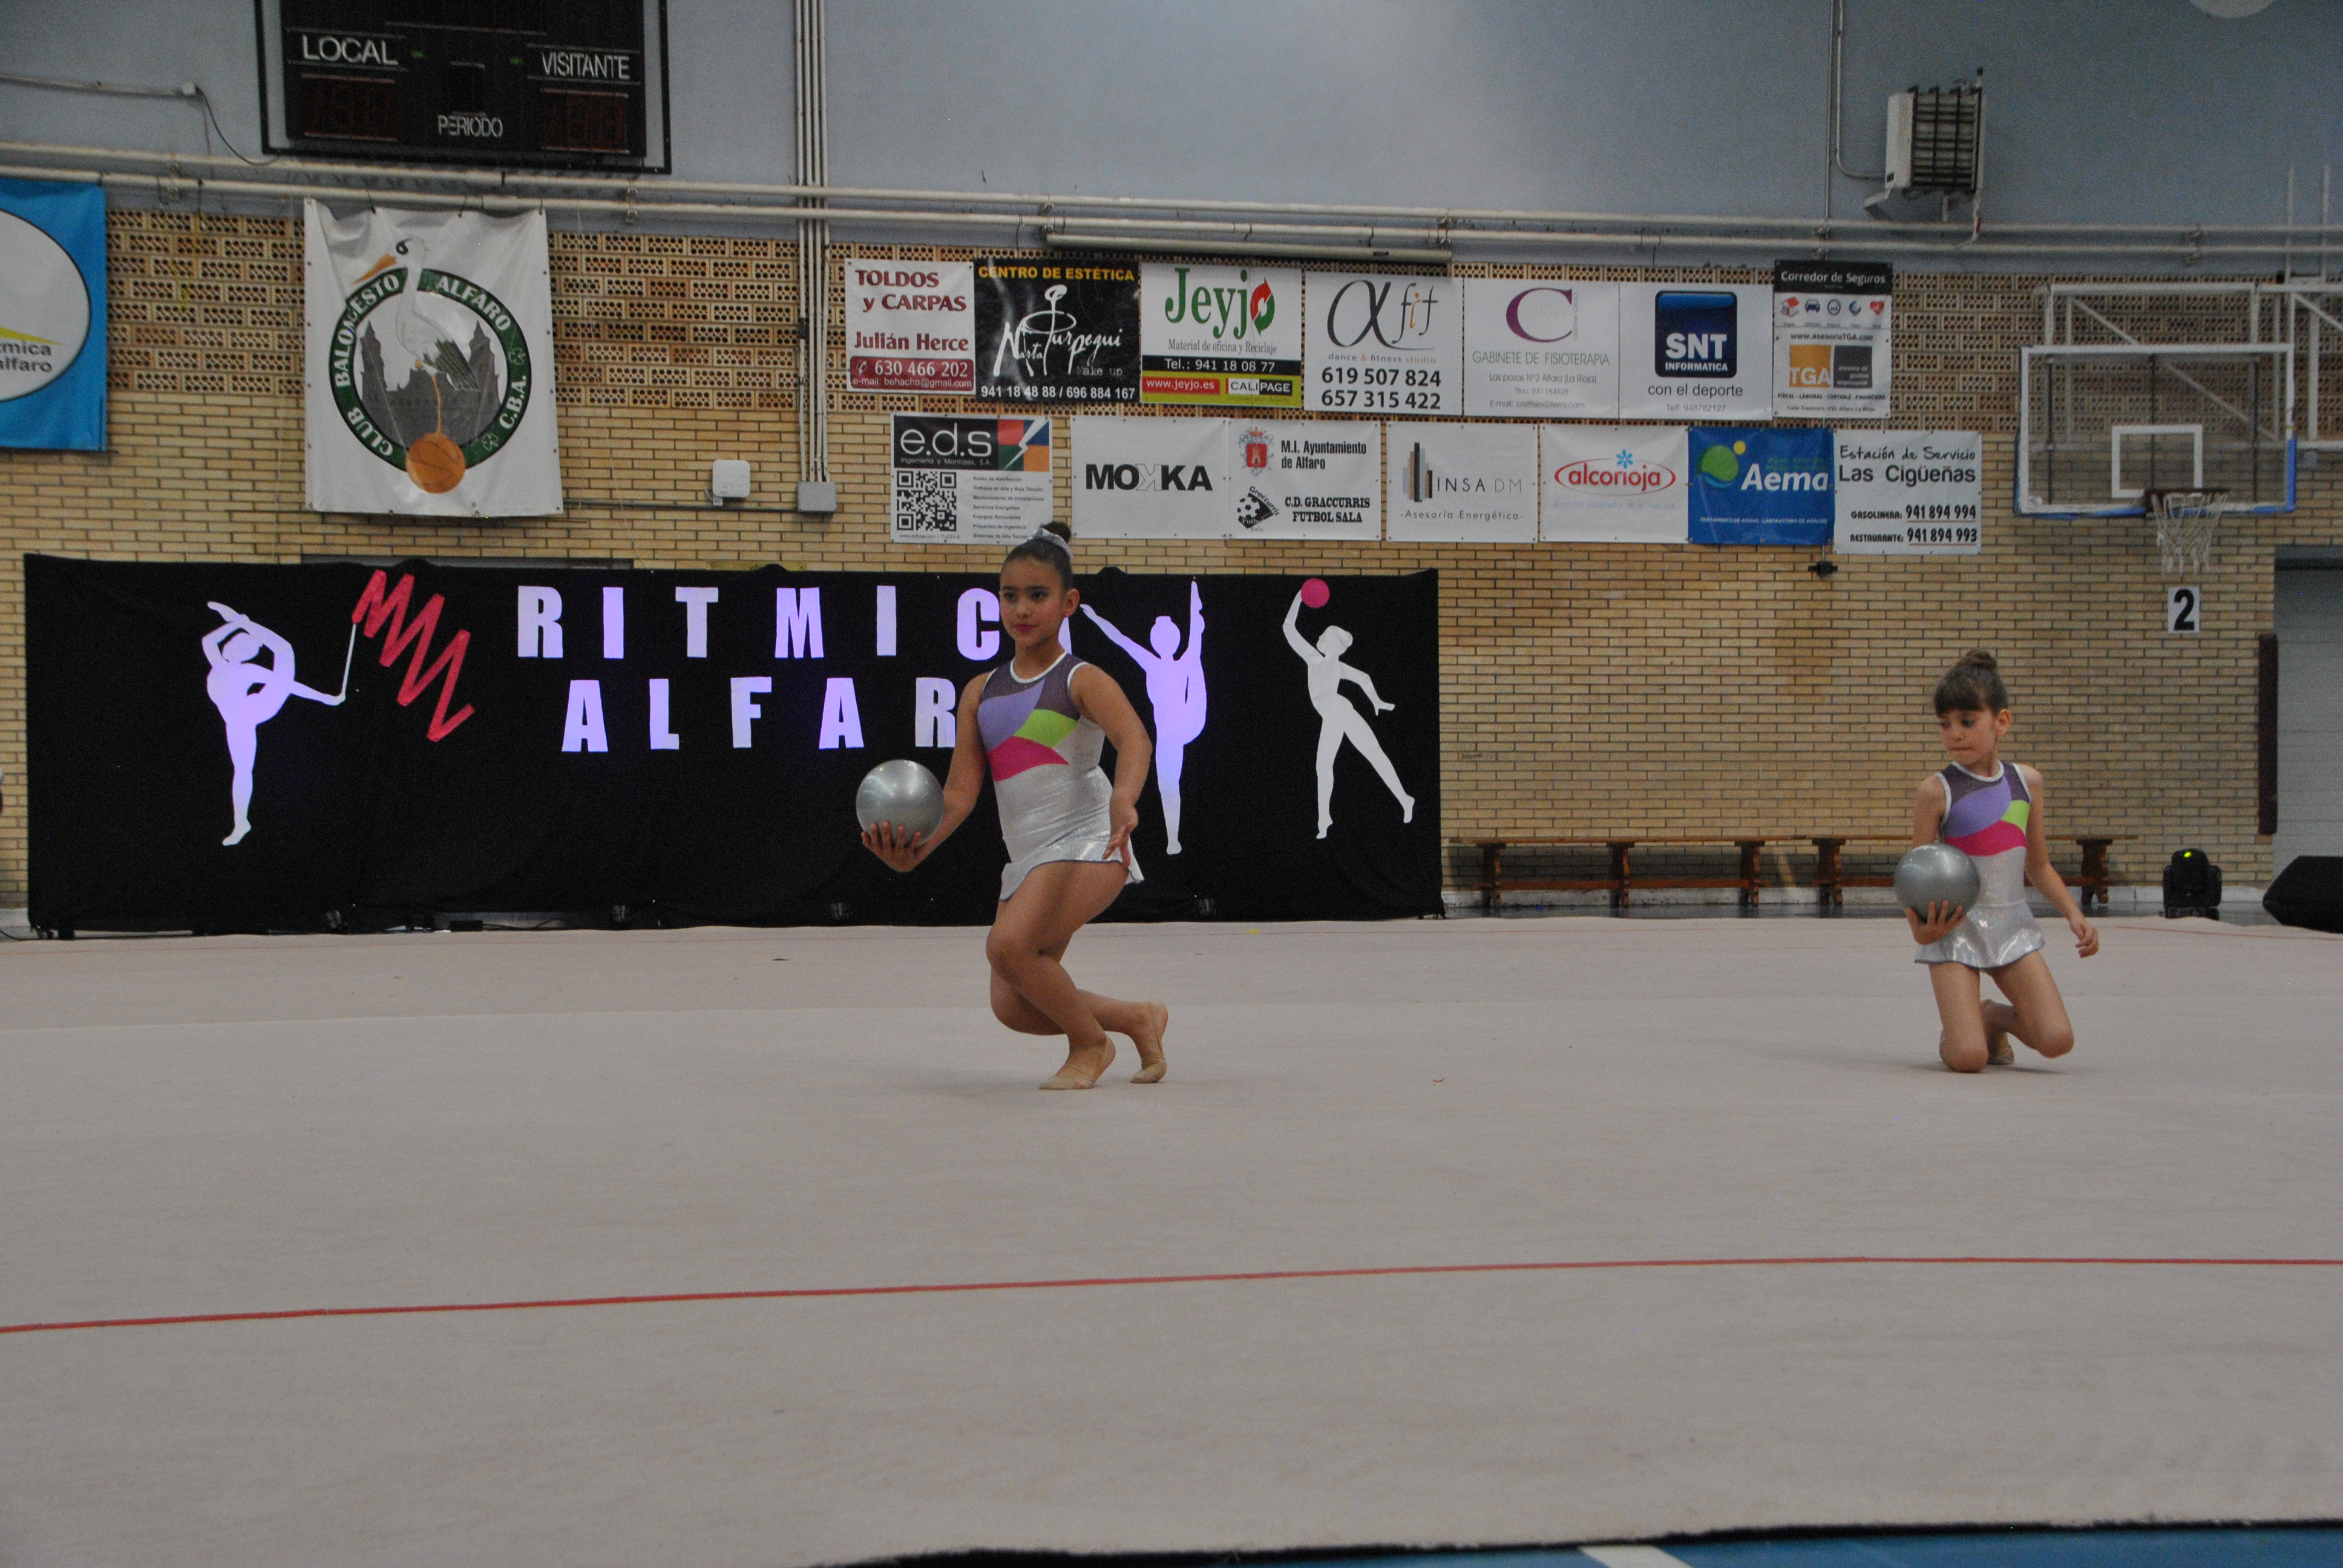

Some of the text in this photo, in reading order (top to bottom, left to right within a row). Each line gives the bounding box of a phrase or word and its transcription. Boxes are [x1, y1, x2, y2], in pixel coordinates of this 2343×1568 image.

[302, 34, 399, 65] LOCAL
[542, 52, 630, 80] VISITANTE
[437, 115, 503, 138] PERIODO
[854, 269, 940, 287] TOLDOS
[978, 266, 1135, 281] CENTRO DE ESTÉTICA
[1781, 271, 1886, 286] Corredor de Seguros
[436, 275, 511, 331] ALFARO
[862, 294, 967, 313] y CARPAS
[854, 332, 969, 351] Julián Herce
[1168, 339, 1277, 355] Material de oficina y Reciclaje
[1665, 333, 1727, 359] SNT
[1165, 358, 1275, 372] Tel.: 941 18 08 77
[1472, 351, 1610, 365] GABINETE DE FISIOTERAPIA
[875, 360, 968, 377] 630 466 202
[1076, 365, 1123, 377] Make up
[1322, 367, 1441, 387] 619 507 824
[1790, 367, 1830, 385] TGA
[1147, 379, 1290, 392] www.jeyjo.es CALIPAGE
[1542, 374, 1562, 382] Alfaro
[981, 385, 1135, 400] 941 18 48 88 696 884 167
[1322, 389, 1440, 410] 657 315 422
[1648, 383, 1743, 399] con el deporte
[499, 374, 526, 430] C.B.A.
[347, 407, 393, 456] CLUB
[1281, 440, 1366, 456] M.I. Ayuntamiento
[1840, 445, 1976, 460] Estación de Servicio
[1282, 456, 1325, 469] de Alfaro
[1568, 462, 1660, 492] alcorioja
[1741, 463, 1829, 491] Aema
[1839, 465, 1976, 487] Las Cigüeñas
[1437, 478, 1522, 493] INSA DM
[1250, 486, 1279, 515] Graccurris
[1285, 496, 1370, 508] C.D. GRACCURRIS
[1293, 511, 1363, 523] FUTBOL SALA
[1851, 505, 1976, 520] GASOLINERA: 941 894 994
[1850, 528, 1978, 543] RESTAURANTE: 941 894 993
[2173, 589, 2195, 631] 2
[517, 584, 1072, 661] RITMIC
[562, 676, 956, 753] ALFAR
